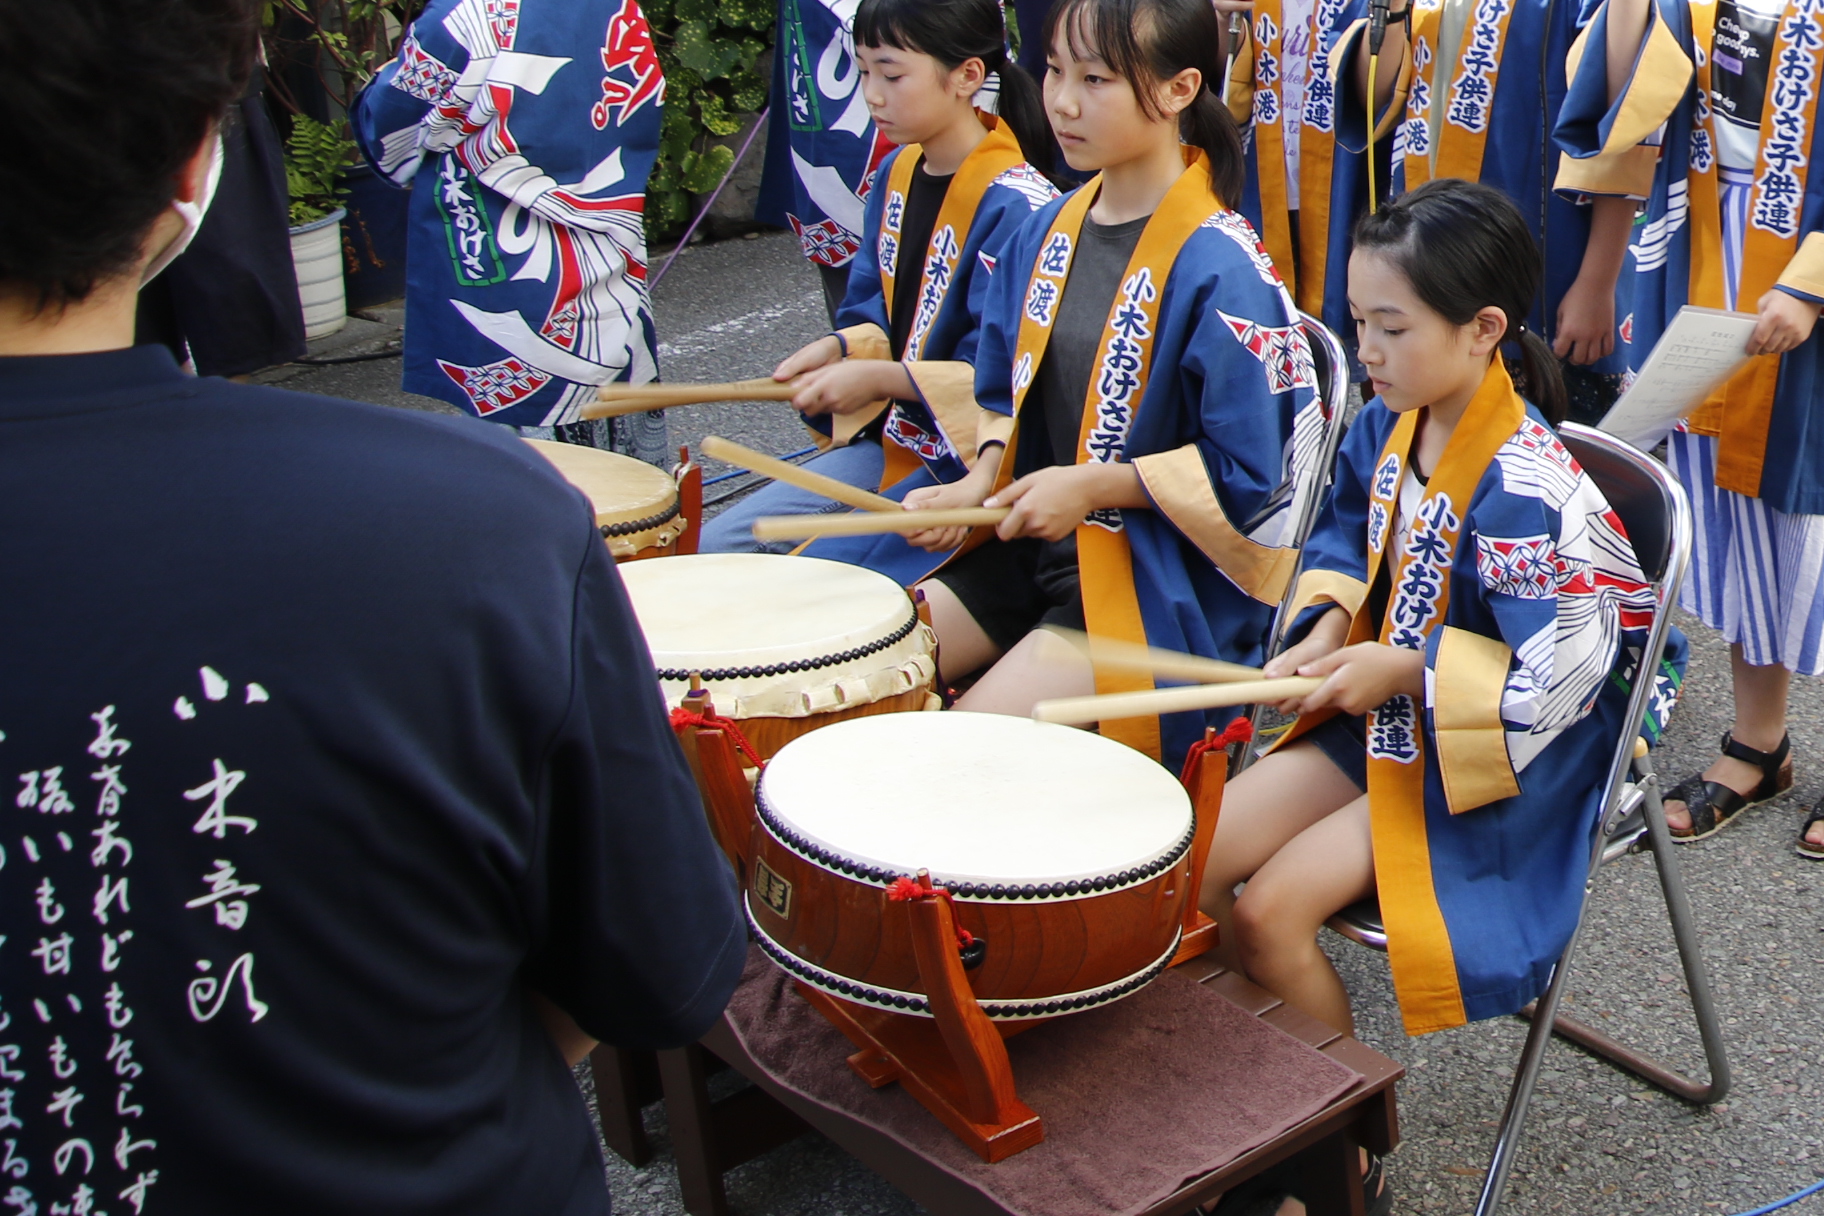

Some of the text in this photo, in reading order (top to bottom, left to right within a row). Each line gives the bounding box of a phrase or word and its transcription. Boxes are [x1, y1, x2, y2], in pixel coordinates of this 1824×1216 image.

[1255, 15, 1280, 123] 小木港
[1406, 38, 1431, 153] 小木港
[880, 191, 904, 275] 佐渡
[1027, 236, 1072, 322] 佐渡
[1368, 457, 1399, 551] 佐渡
[1371, 496, 1458, 761] 小木おけさ供連
[174, 665, 270, 1023] 小木音頭
